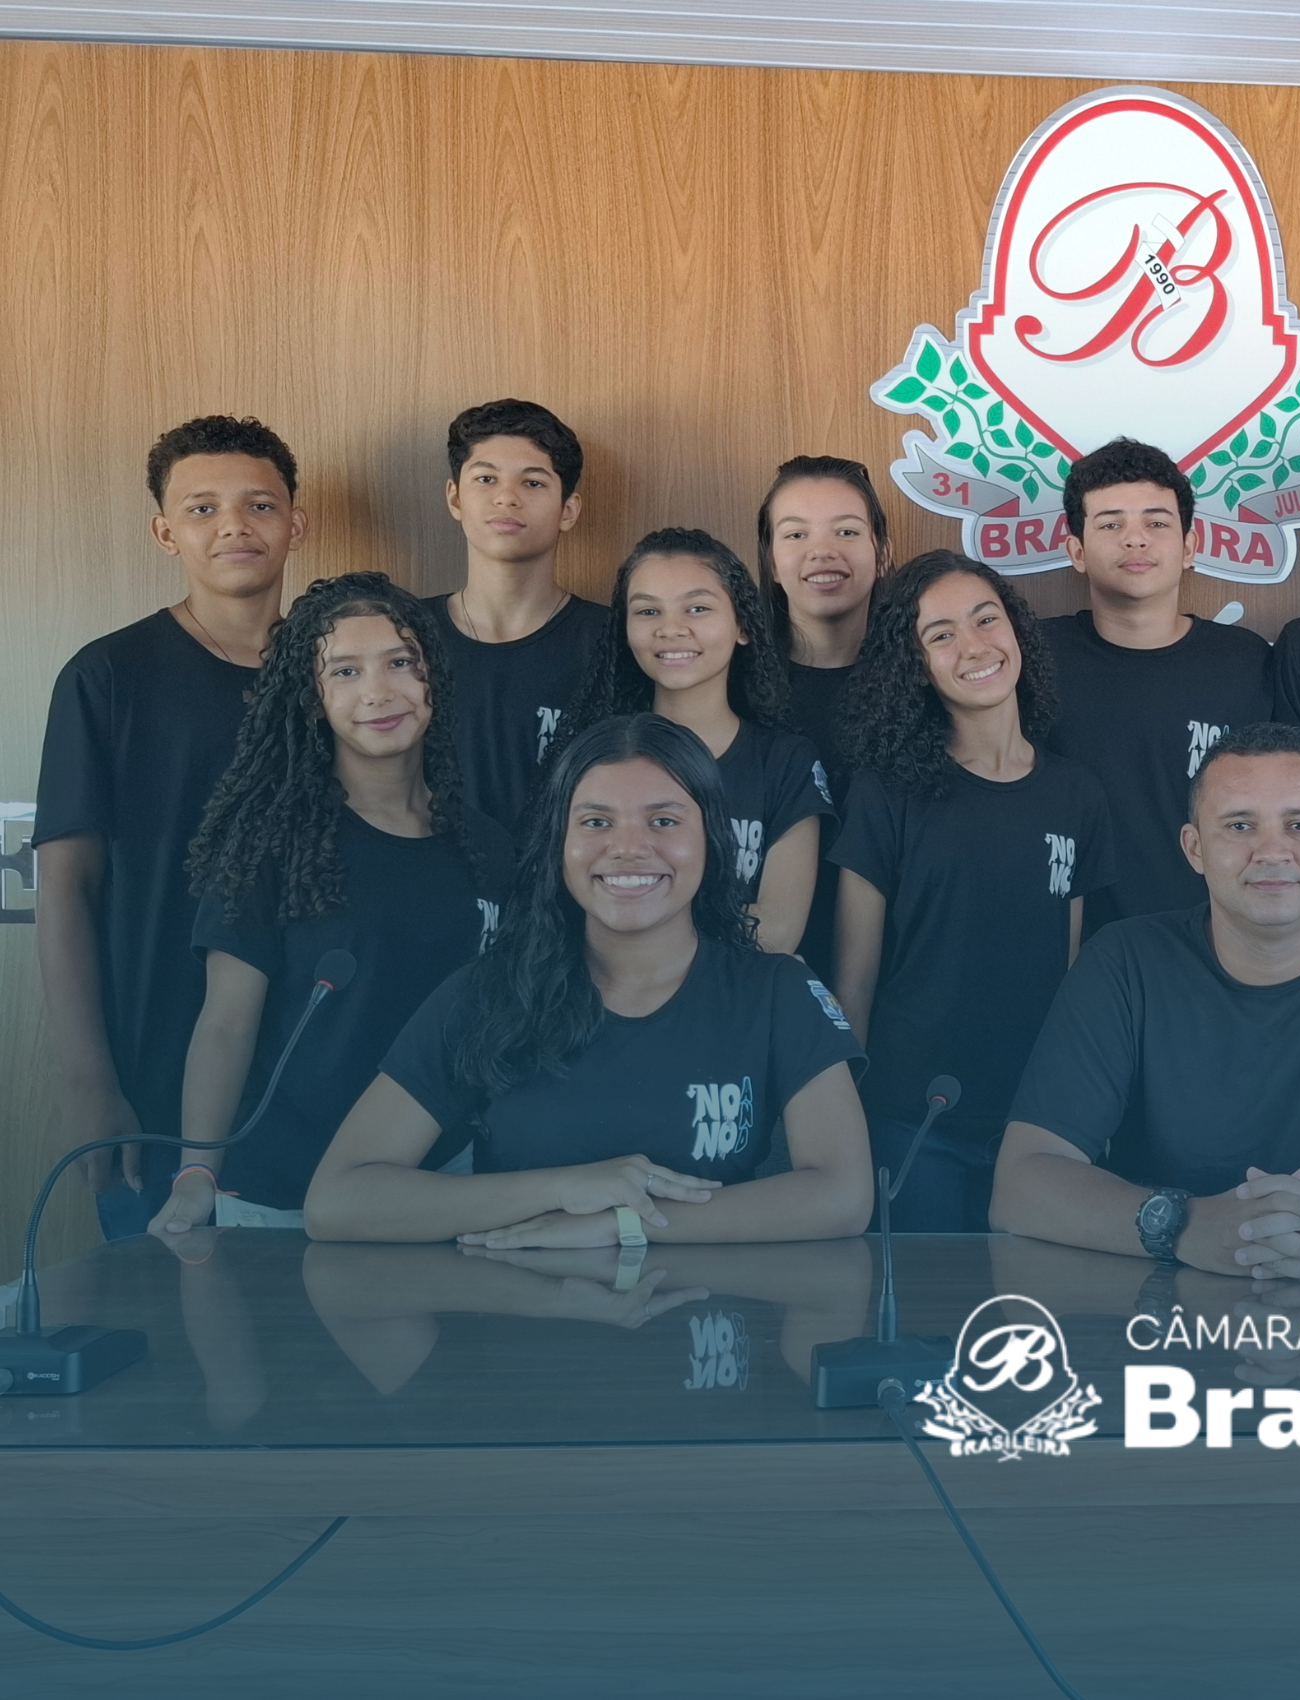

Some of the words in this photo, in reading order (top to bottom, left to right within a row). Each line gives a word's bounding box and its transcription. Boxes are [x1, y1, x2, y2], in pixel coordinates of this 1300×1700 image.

[1144, 254, 1175, 295] 1990
[932, 472, 970, 506] 31
[981, 513, 1274, 567] BRAIRA
[1044, 833, 1075, 867] NO
[686, 1083, 741, 1128] NO
[691, 1121, 738, 1162] NO
